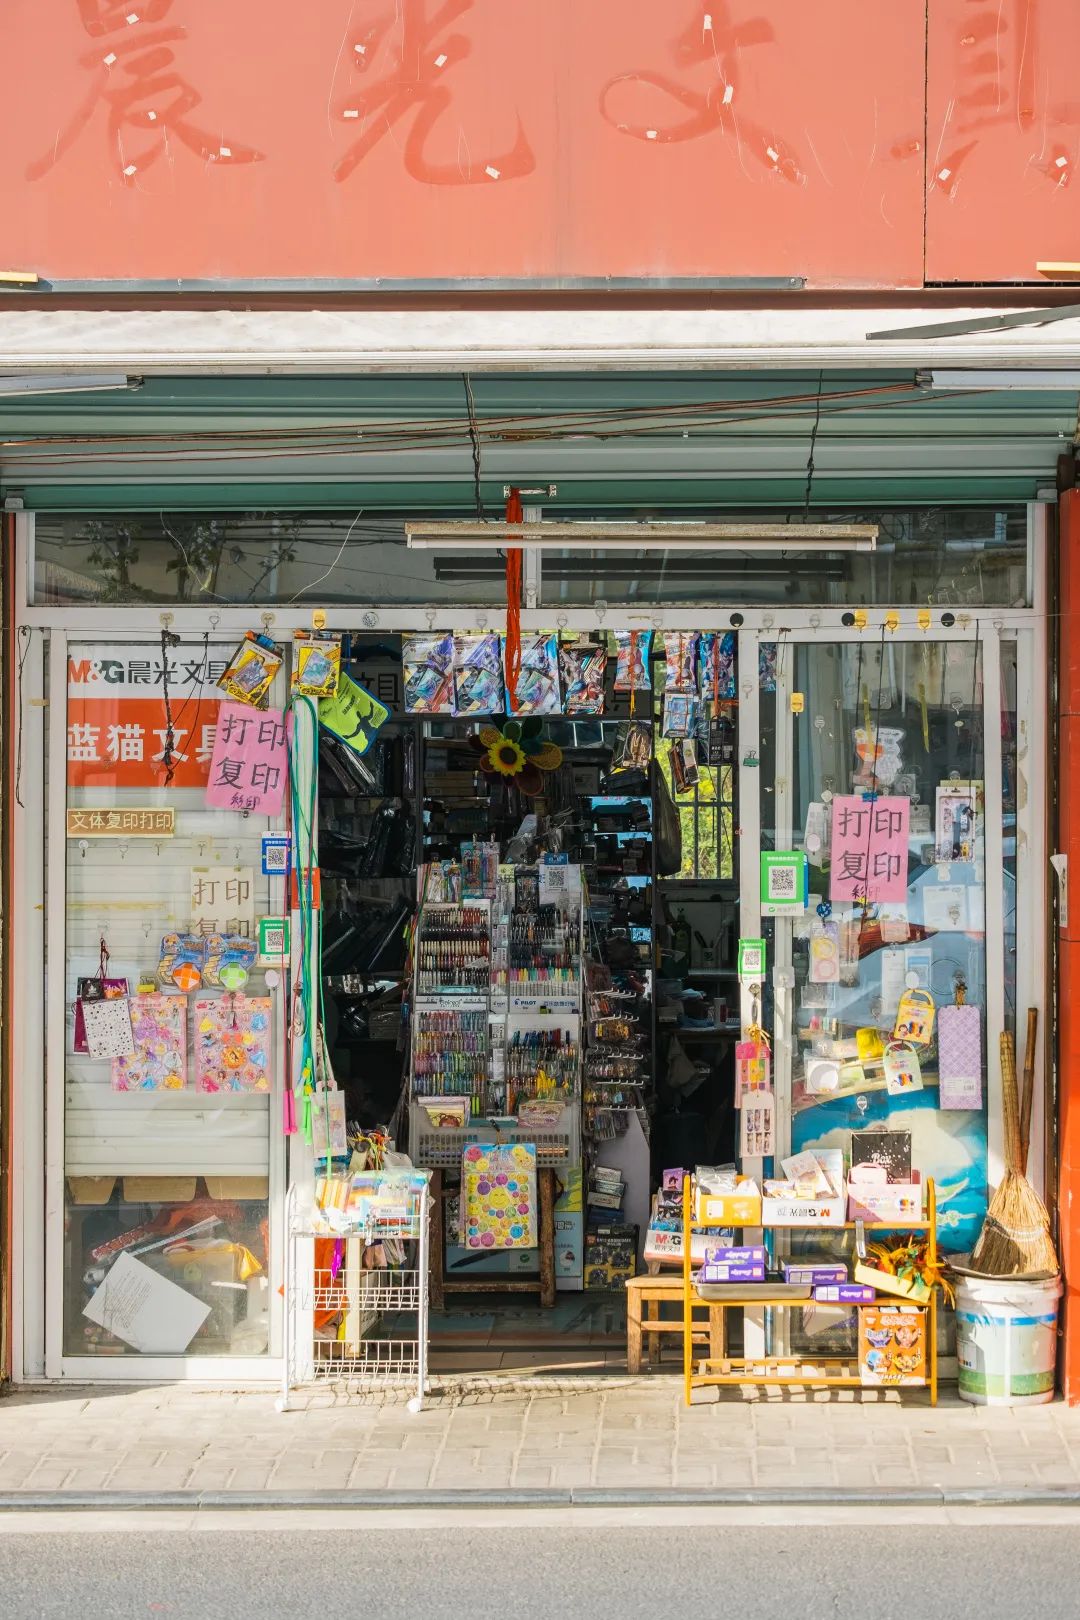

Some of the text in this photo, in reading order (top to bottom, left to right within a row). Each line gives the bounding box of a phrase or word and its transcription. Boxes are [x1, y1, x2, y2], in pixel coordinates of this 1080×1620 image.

[222, 713, 287, 751] 打印
[213, 756, 281, 794] 复印
[70, 811, 172, 830] 文体复印打印
[837, 806, 903, 840] 打印
[836, 849, 901, 883] 复印
[193, 878, 250, 906] 打印
